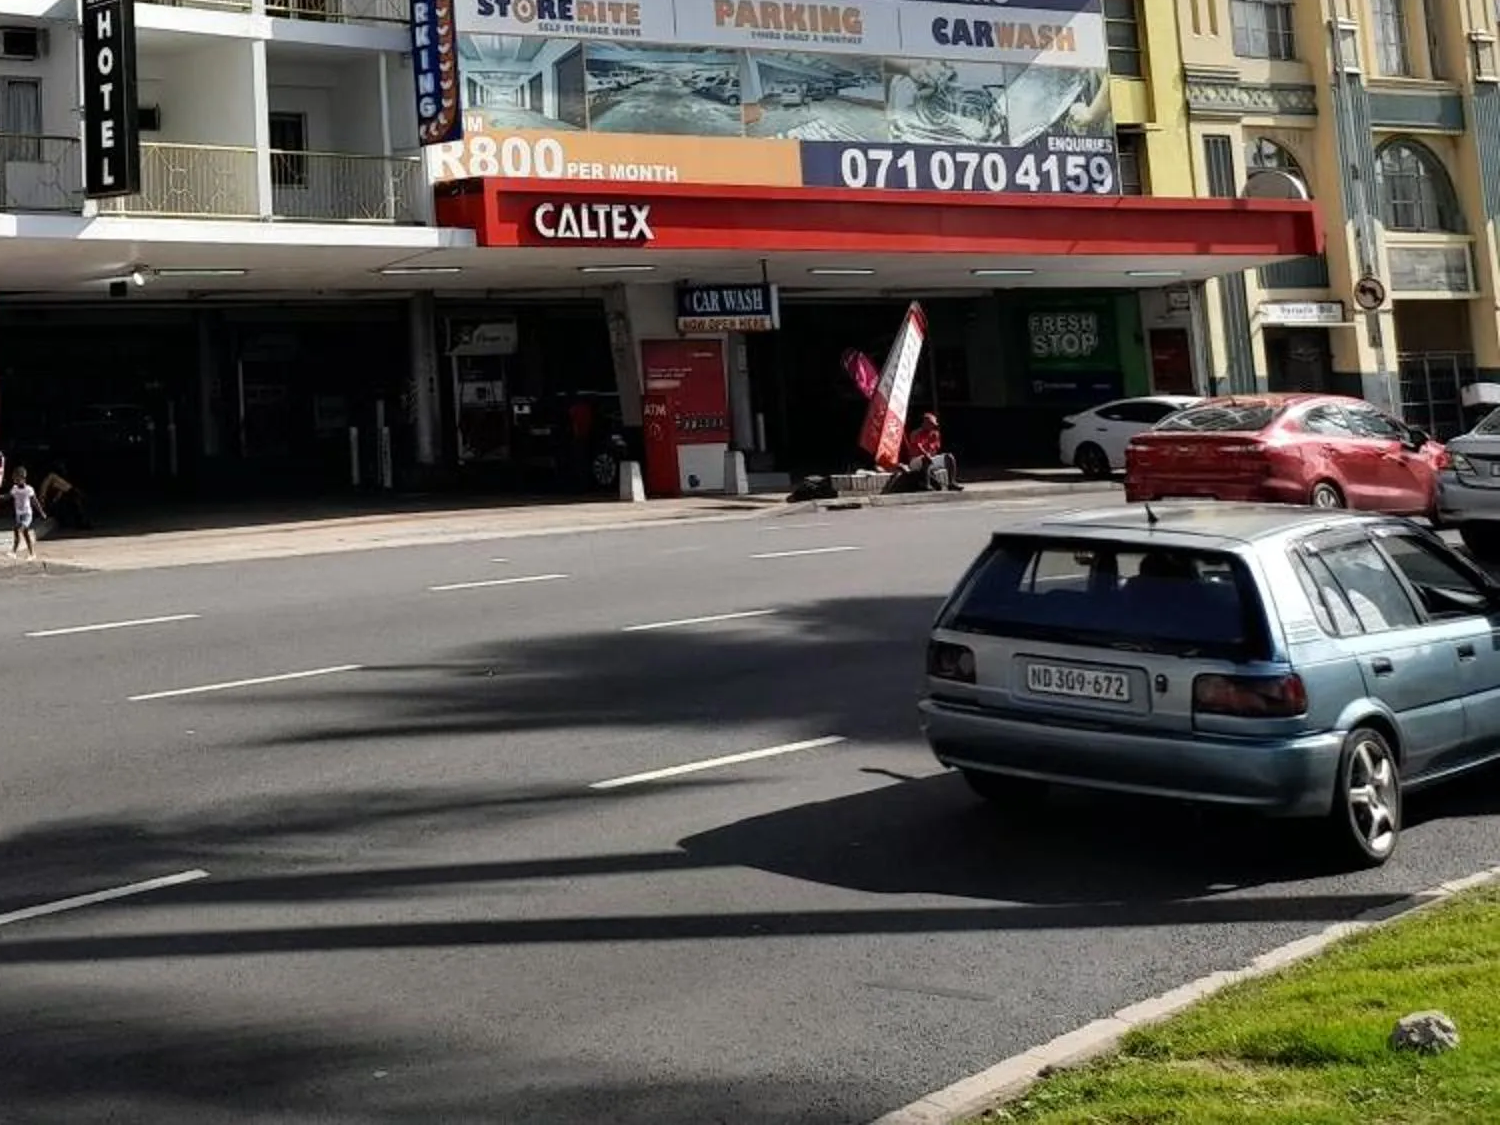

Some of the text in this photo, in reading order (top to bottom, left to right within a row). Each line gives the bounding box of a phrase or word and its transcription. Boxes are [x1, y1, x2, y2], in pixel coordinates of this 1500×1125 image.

[931, 16, 1076, 52] CARWASH
[97, 9, 115, 186] HOTEL
[431, 136, 678, 183] R800 PER MONTH
[1048, 136, 1113, 153] ENQUIRIES
[840, 148, 1113, 194] 071 070 4159
[534, 202, 655, 240] CALTEX
[692, 288, 764, 313] CAR WASH
[1029, 313, 1096, 333] FRESH
[1032, 331, 1098, 358] STOP
[1030, 666, 1125, 697] ND 309-672
